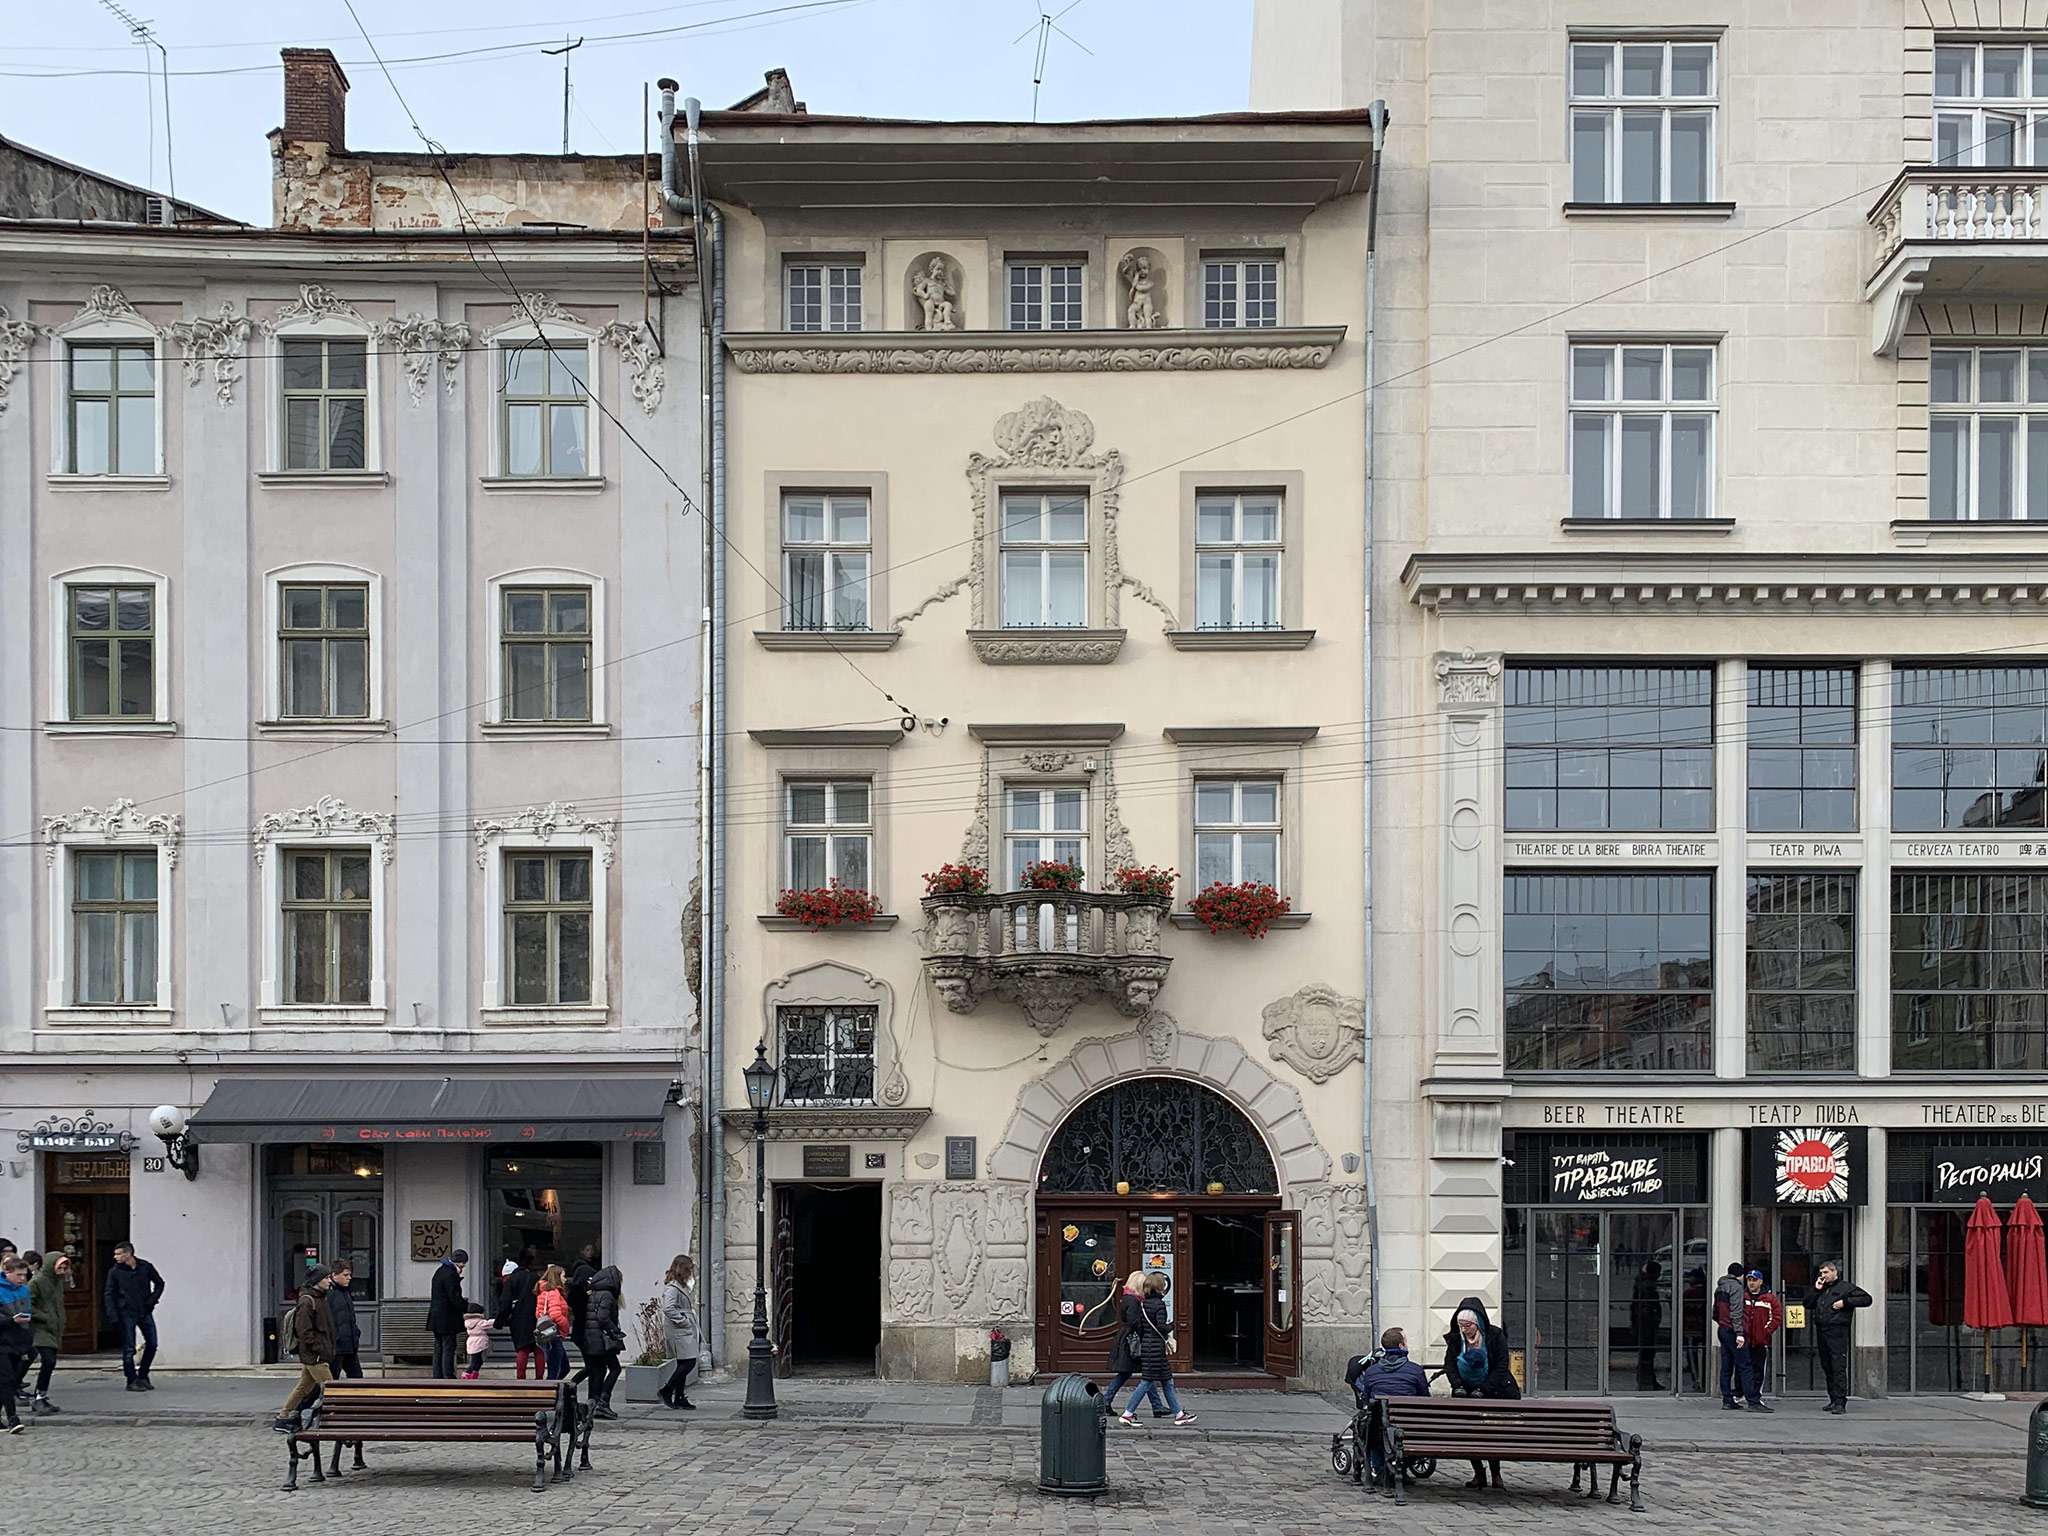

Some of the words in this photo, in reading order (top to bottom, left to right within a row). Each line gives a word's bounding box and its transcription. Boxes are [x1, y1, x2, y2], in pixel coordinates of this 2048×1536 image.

[1515, 844, 1557, 856] THEATRE
[1562, 844, 1574, 856] DE
[1578, 844, 1591, 856] LA
[1595, 844, 1620, 856] BIERE
[1632, 844, 1662, 856] BIRRA
[1666, 844, 1706, 856] THEATRE
[1769, 844, 1804, 856] TEATR
[1813, 844, 1842, 856] PIWA
[1907, 844, 1953, 856] CERVEZA
[1959, 844, 2000, 856] TEATRO
[1544, 1105, 1585, 1124] BEER
[1604, 1105, 1685, 1124] THEATRE
[1748, 1105, 1802, 1123] ТЕАТР
[1816, 1105, 1859, 1123] ПИВА
[1921, 1104, 1996, 1123] THEATER
[2000, 1114, 2018, 1123] DES
[33, 1136, 116, 1147] КАФЕ-БАР
[1552, 1155, 1575, 1168] ТУТ
[1576, 1150, 1610, 1166] ВАРЯТЬ
[1785, 1156, 1836, 1173] ПРАВДА
[1554, 1158, 1658, 1193] ПРАВДИВЕ
[1632, 1177, 1663, 1194] ПИВО
[1165, 1225, 1171, 1233] A
[1145, 1233, 1172, 1242] PARTY
[1145, 1243, 1172, 1252] TIME!
